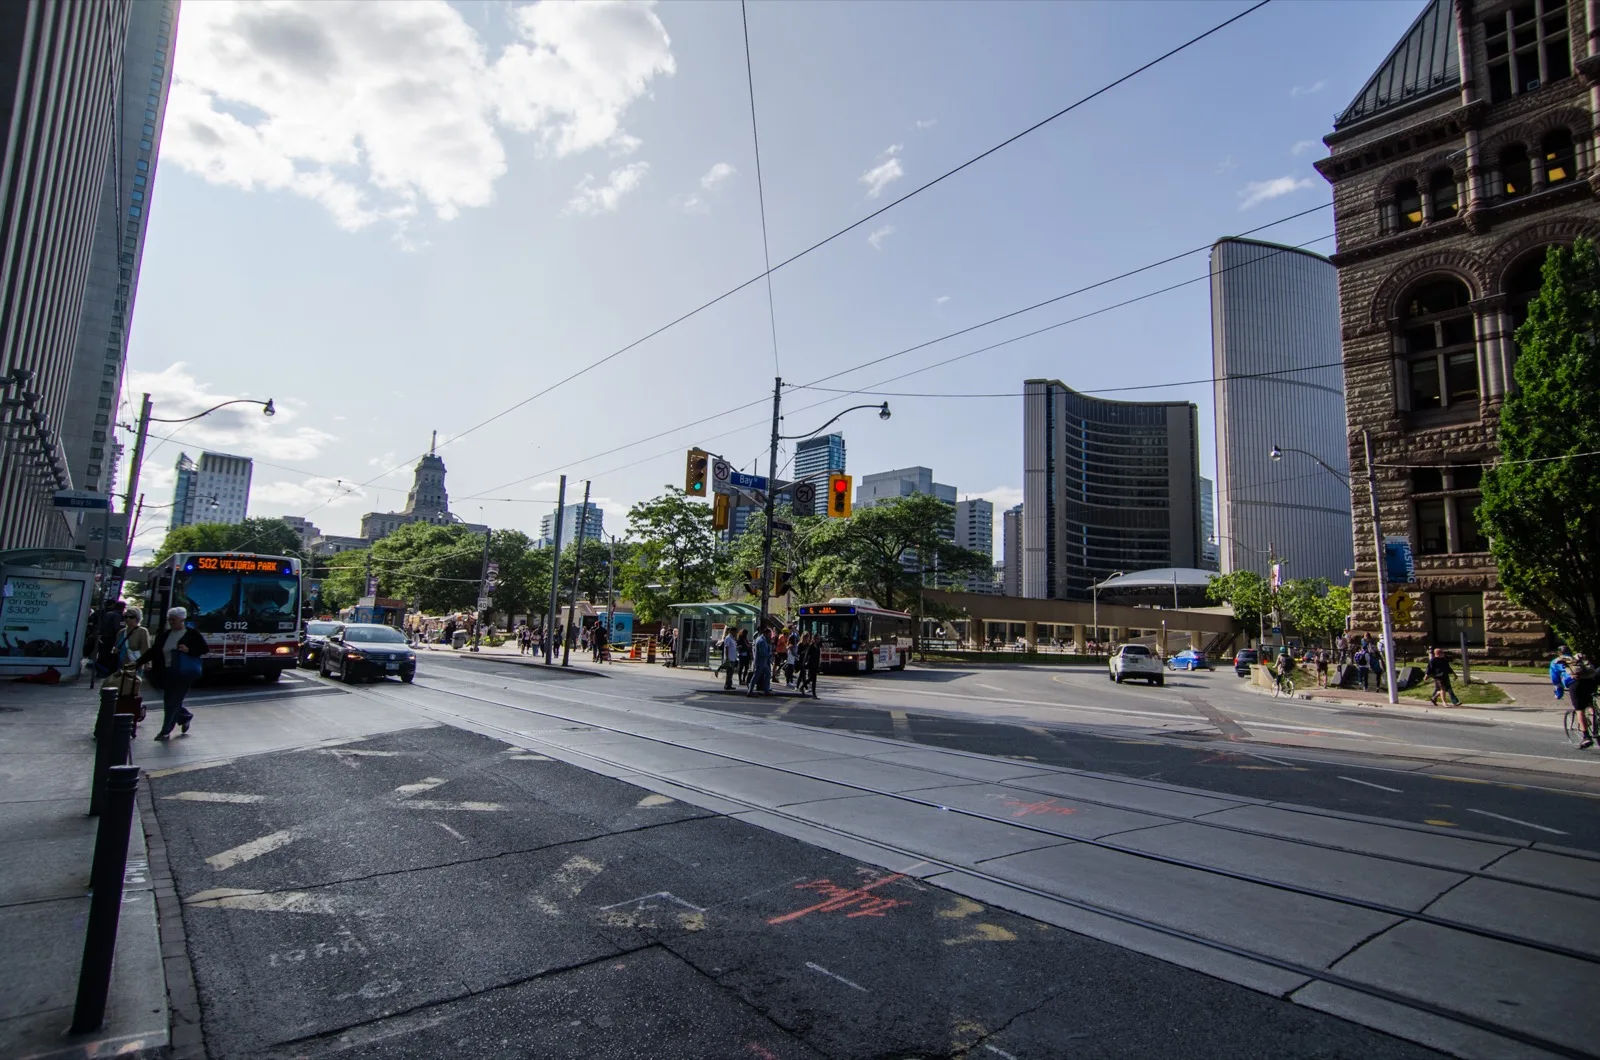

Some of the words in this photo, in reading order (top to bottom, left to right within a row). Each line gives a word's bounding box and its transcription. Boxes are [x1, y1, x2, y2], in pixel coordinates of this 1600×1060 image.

[739, 475, 754, 487] Bay
[70, 498, 84, 506] Bay
[198, 558, 218, 569] 502
[220, 560, 256, 570] VICTORIA
[257, 561, 277, 571] PARK
[12, 581, 41, 590] Who's
[13, 591, 39, 599] eady
[40, 591, 53, 599] for
[24, 599, 48, 607] extra
[7, 606, 40, 614] $300?
[809, 607, 814, 615] 6
[224, 621, 248, 630] 8112
